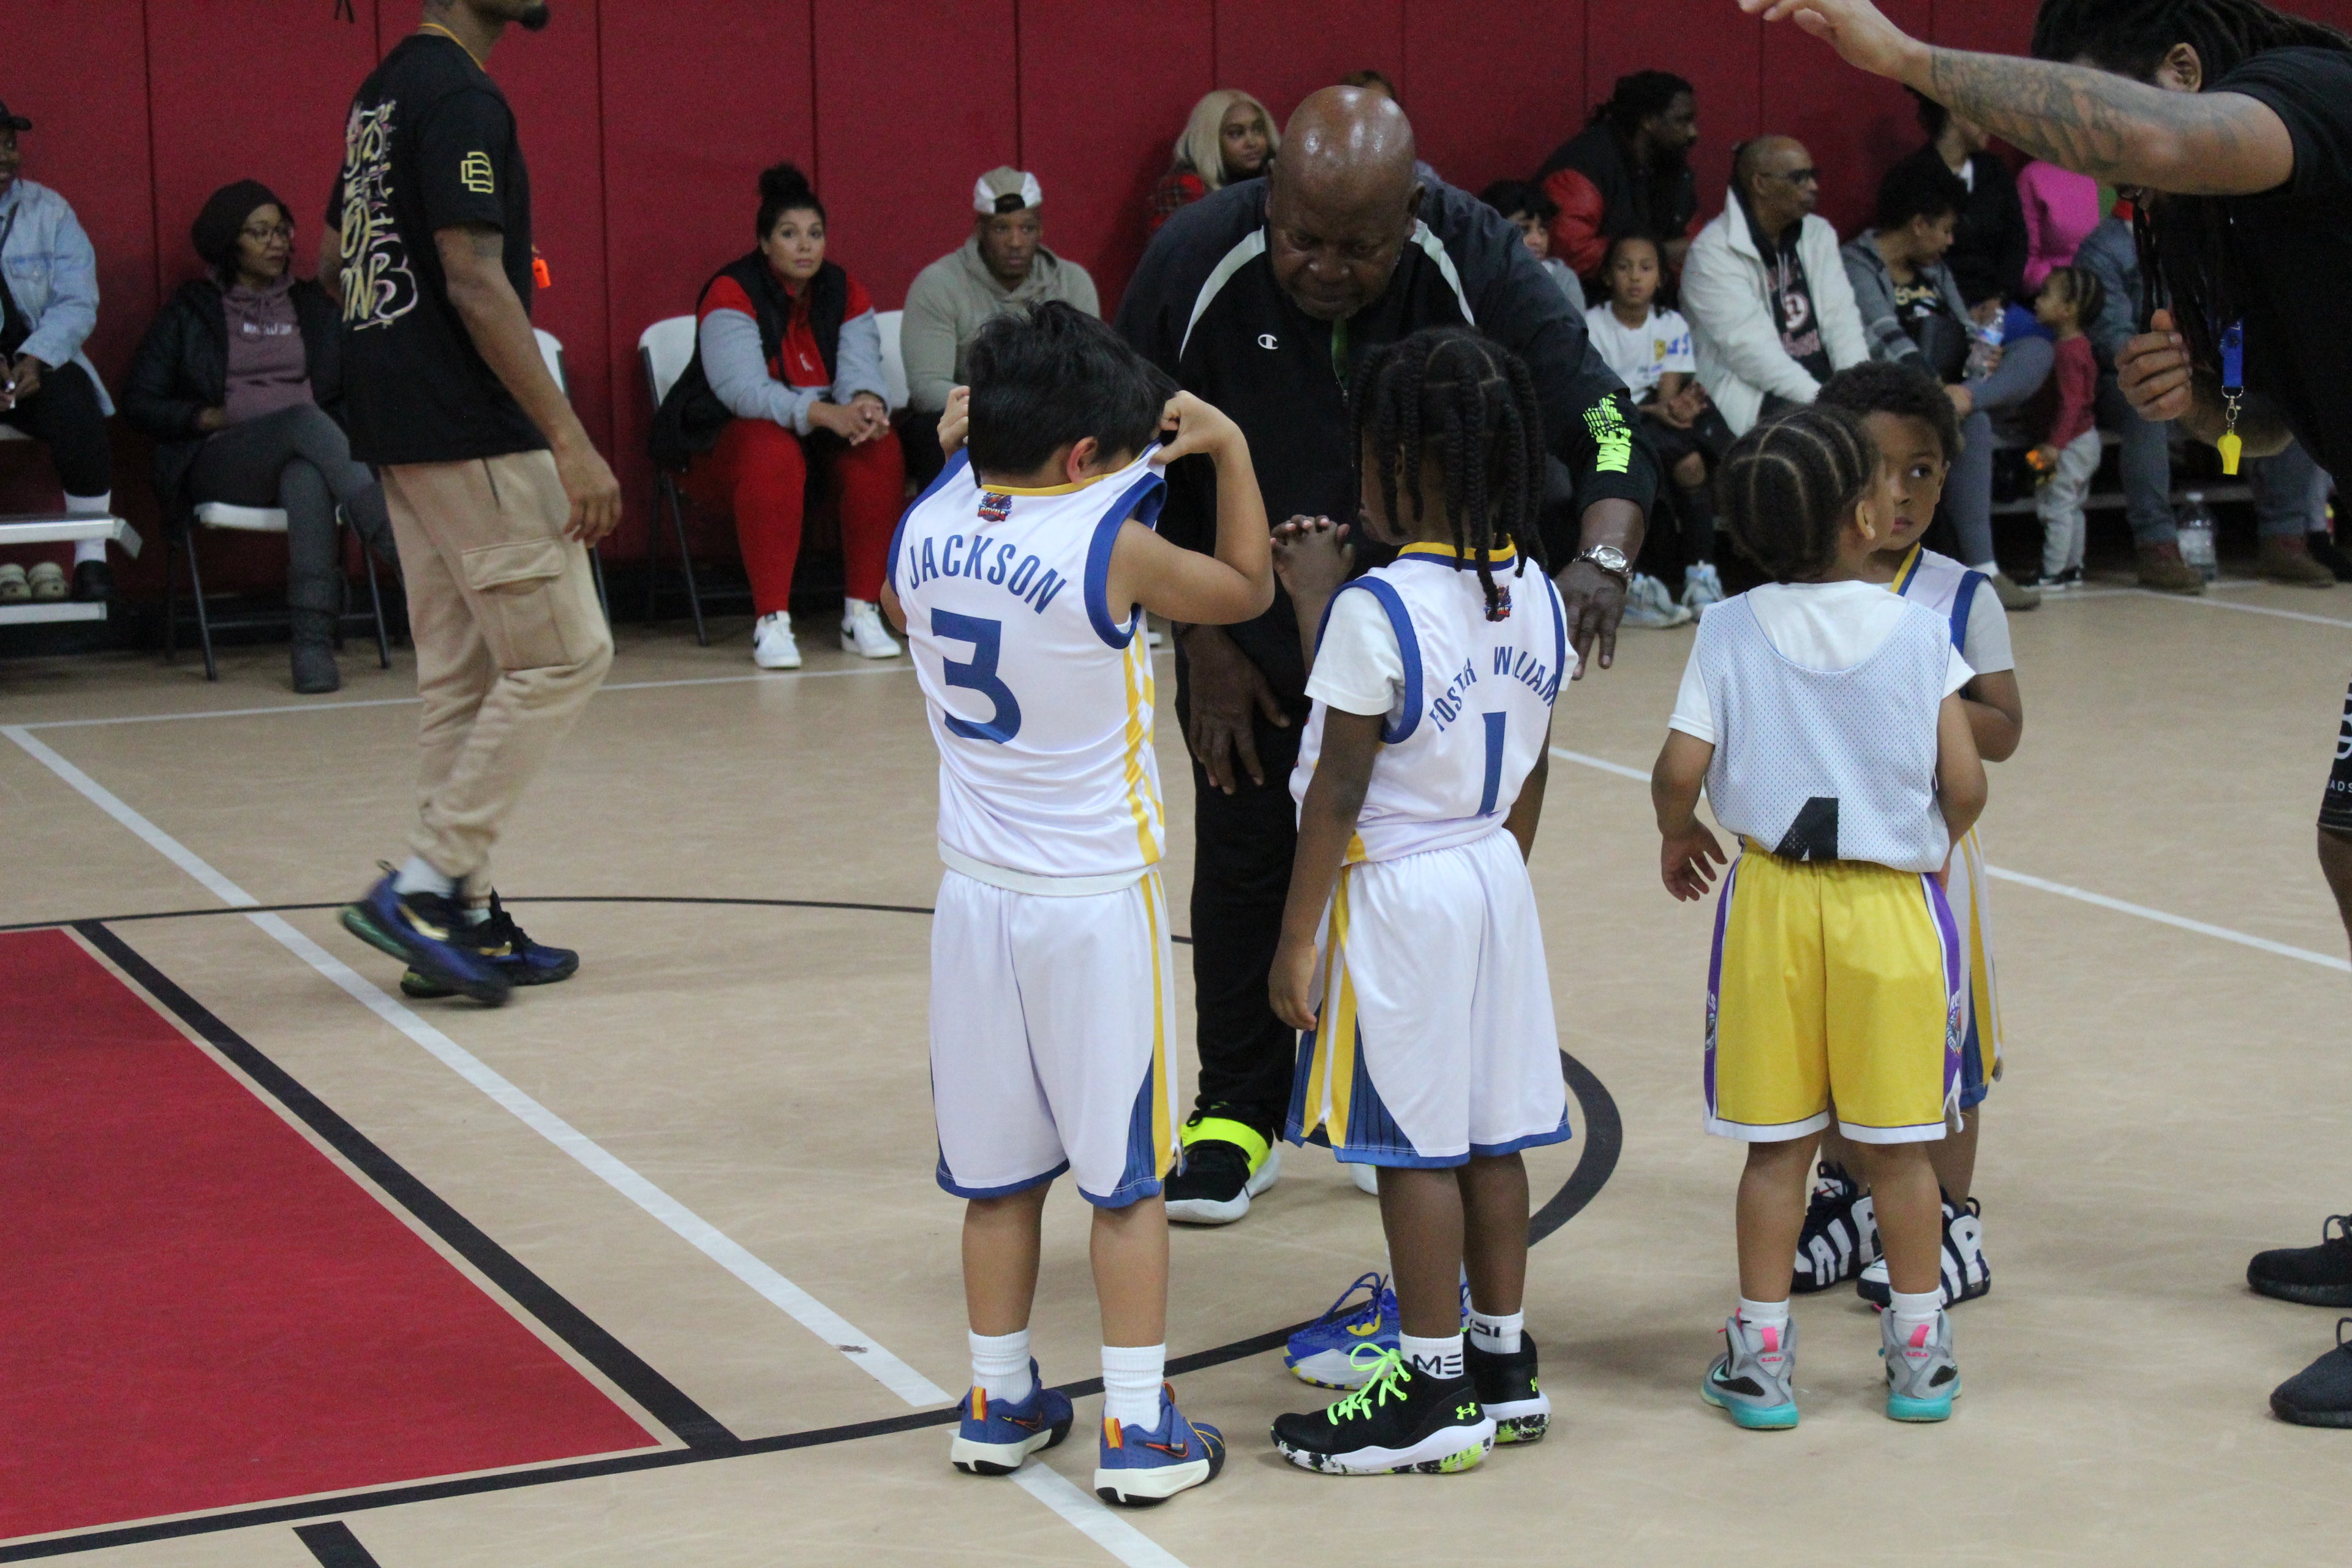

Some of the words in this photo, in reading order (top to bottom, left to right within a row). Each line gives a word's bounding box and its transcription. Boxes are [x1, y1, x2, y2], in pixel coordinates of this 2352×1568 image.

[910, 535, 1066, 614] JACKSON
[930, 607, 1021, 744] 3
[1476, 711, 1506, 818] 1
